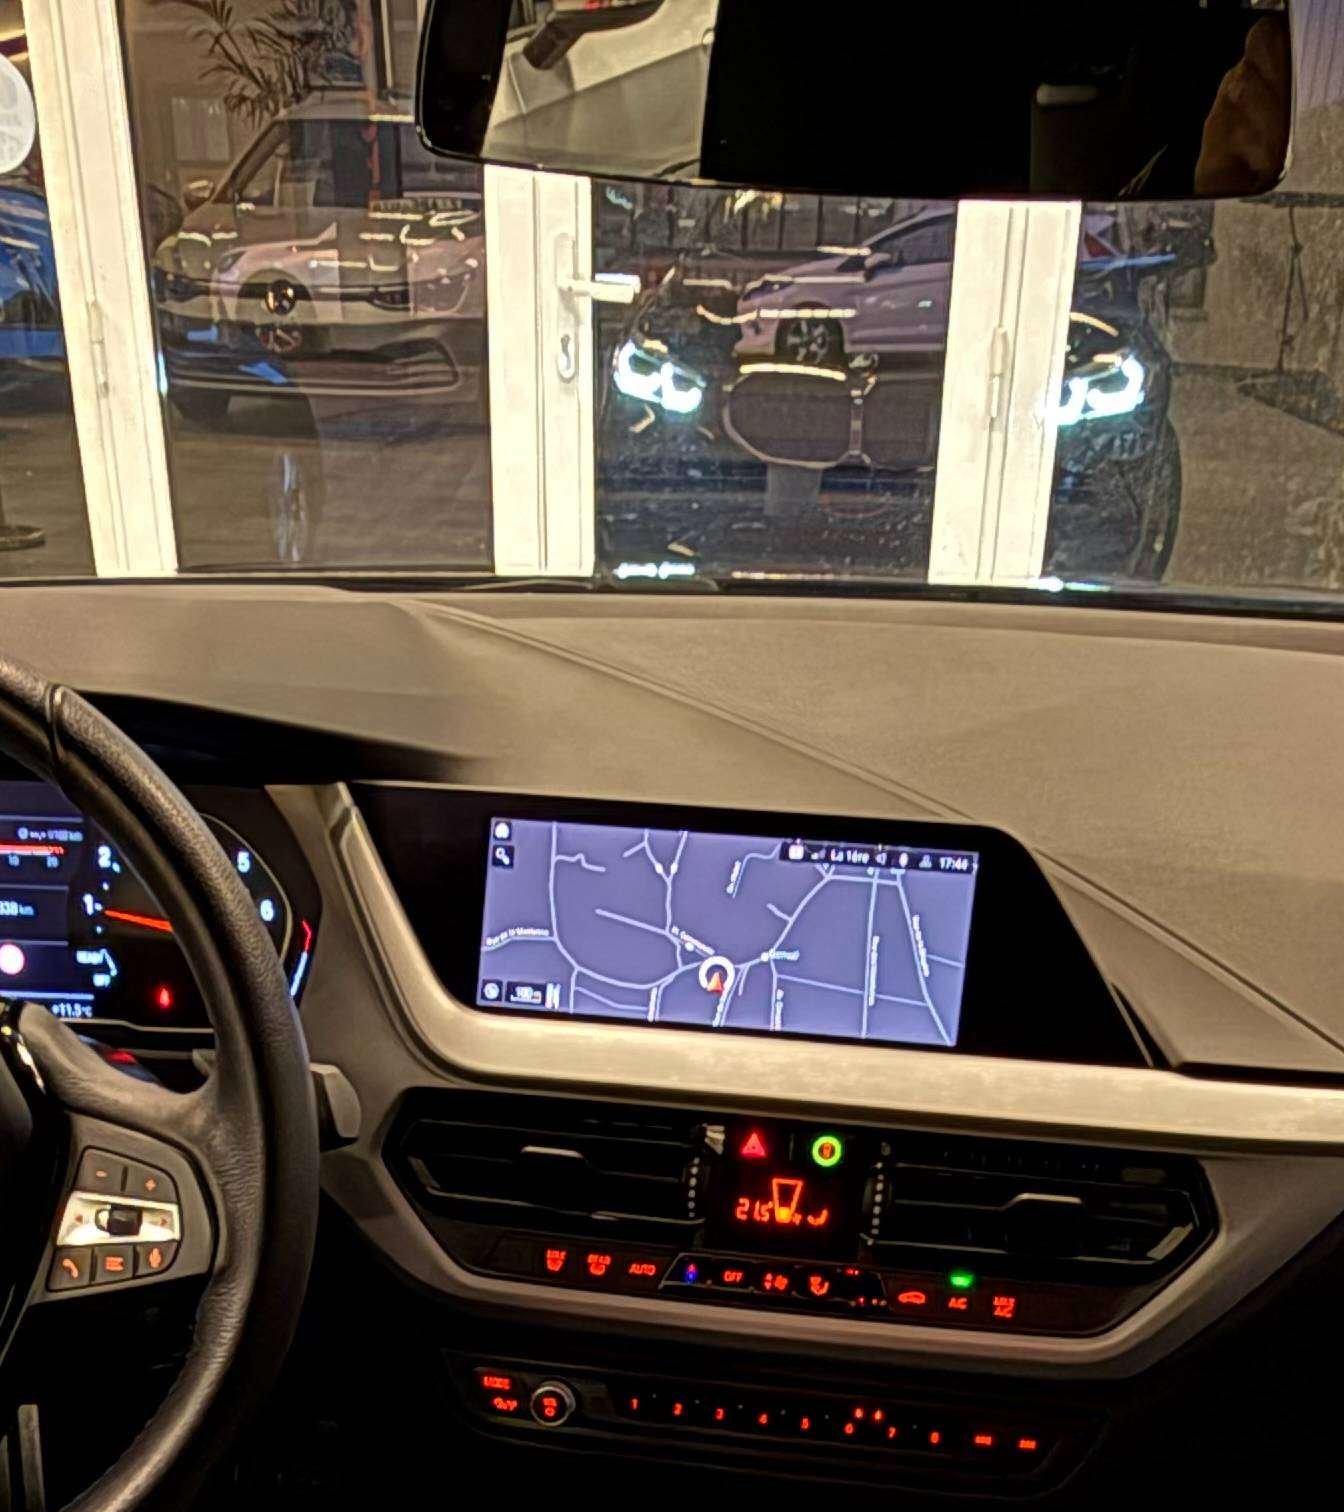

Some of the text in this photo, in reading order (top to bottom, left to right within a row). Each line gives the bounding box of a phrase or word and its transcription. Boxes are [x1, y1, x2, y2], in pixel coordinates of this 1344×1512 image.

[98, 845, 111, 868] 2
[237, 851, 250, 872] 5
[83, 893, 94, 915] 1
[629, 1263, 656, 1275] AUTO
